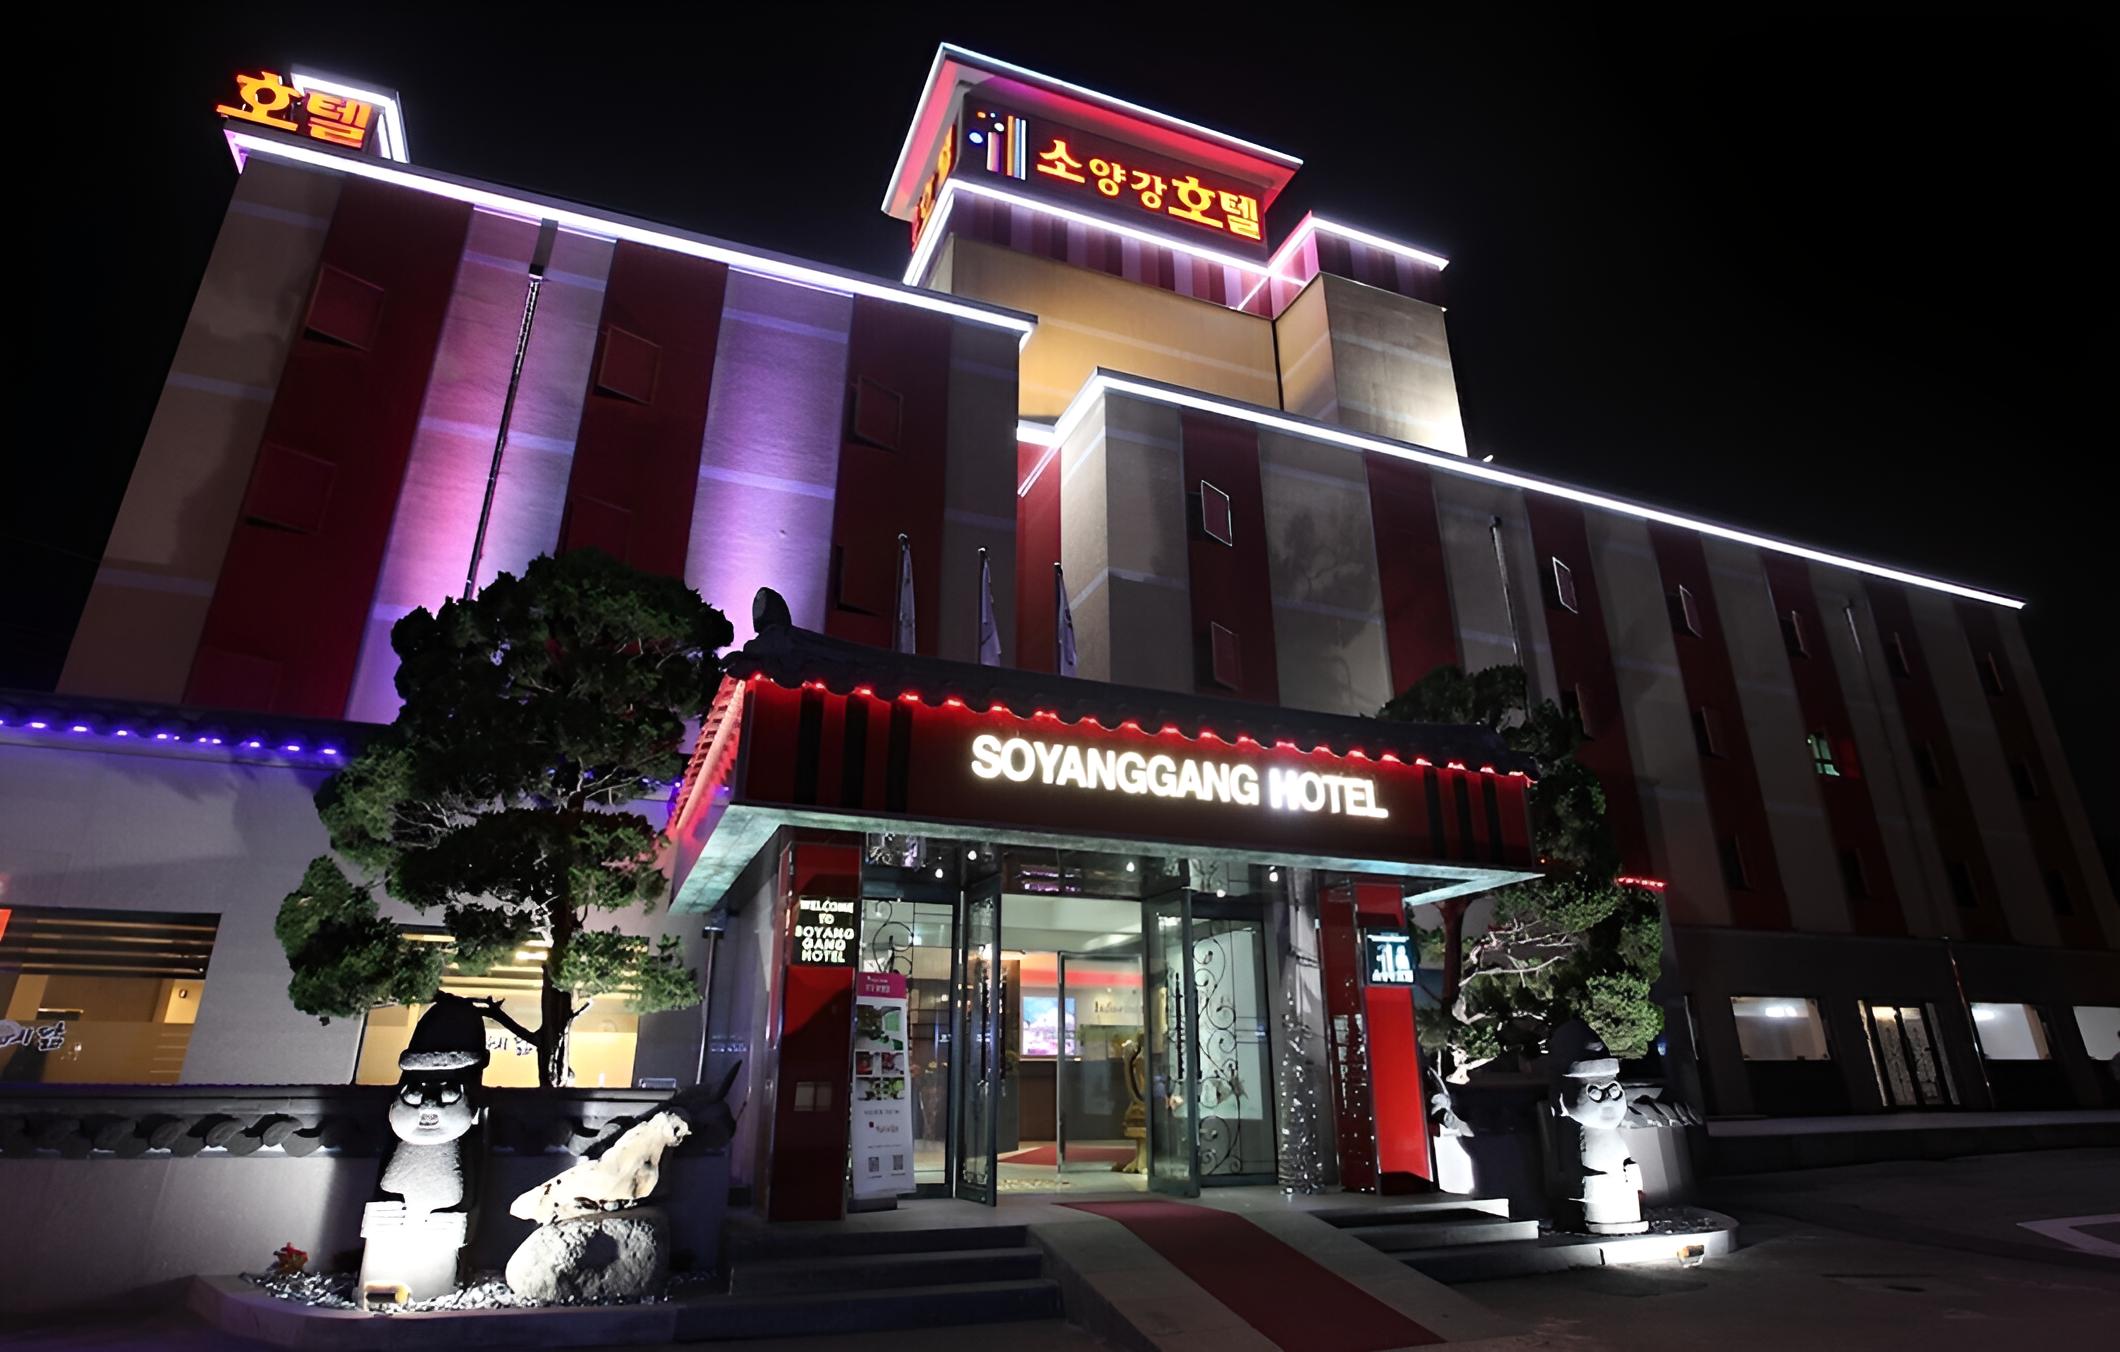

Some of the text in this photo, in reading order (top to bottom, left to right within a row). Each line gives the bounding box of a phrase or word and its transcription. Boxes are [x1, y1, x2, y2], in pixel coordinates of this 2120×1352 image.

[216, 71, 372, 149] 호텔
[971, 734, 1390, 819] SOYANGGANG HOTEL
[818, 912, 835, 925] TO
[801, 949, 846, 963] HOTEL
